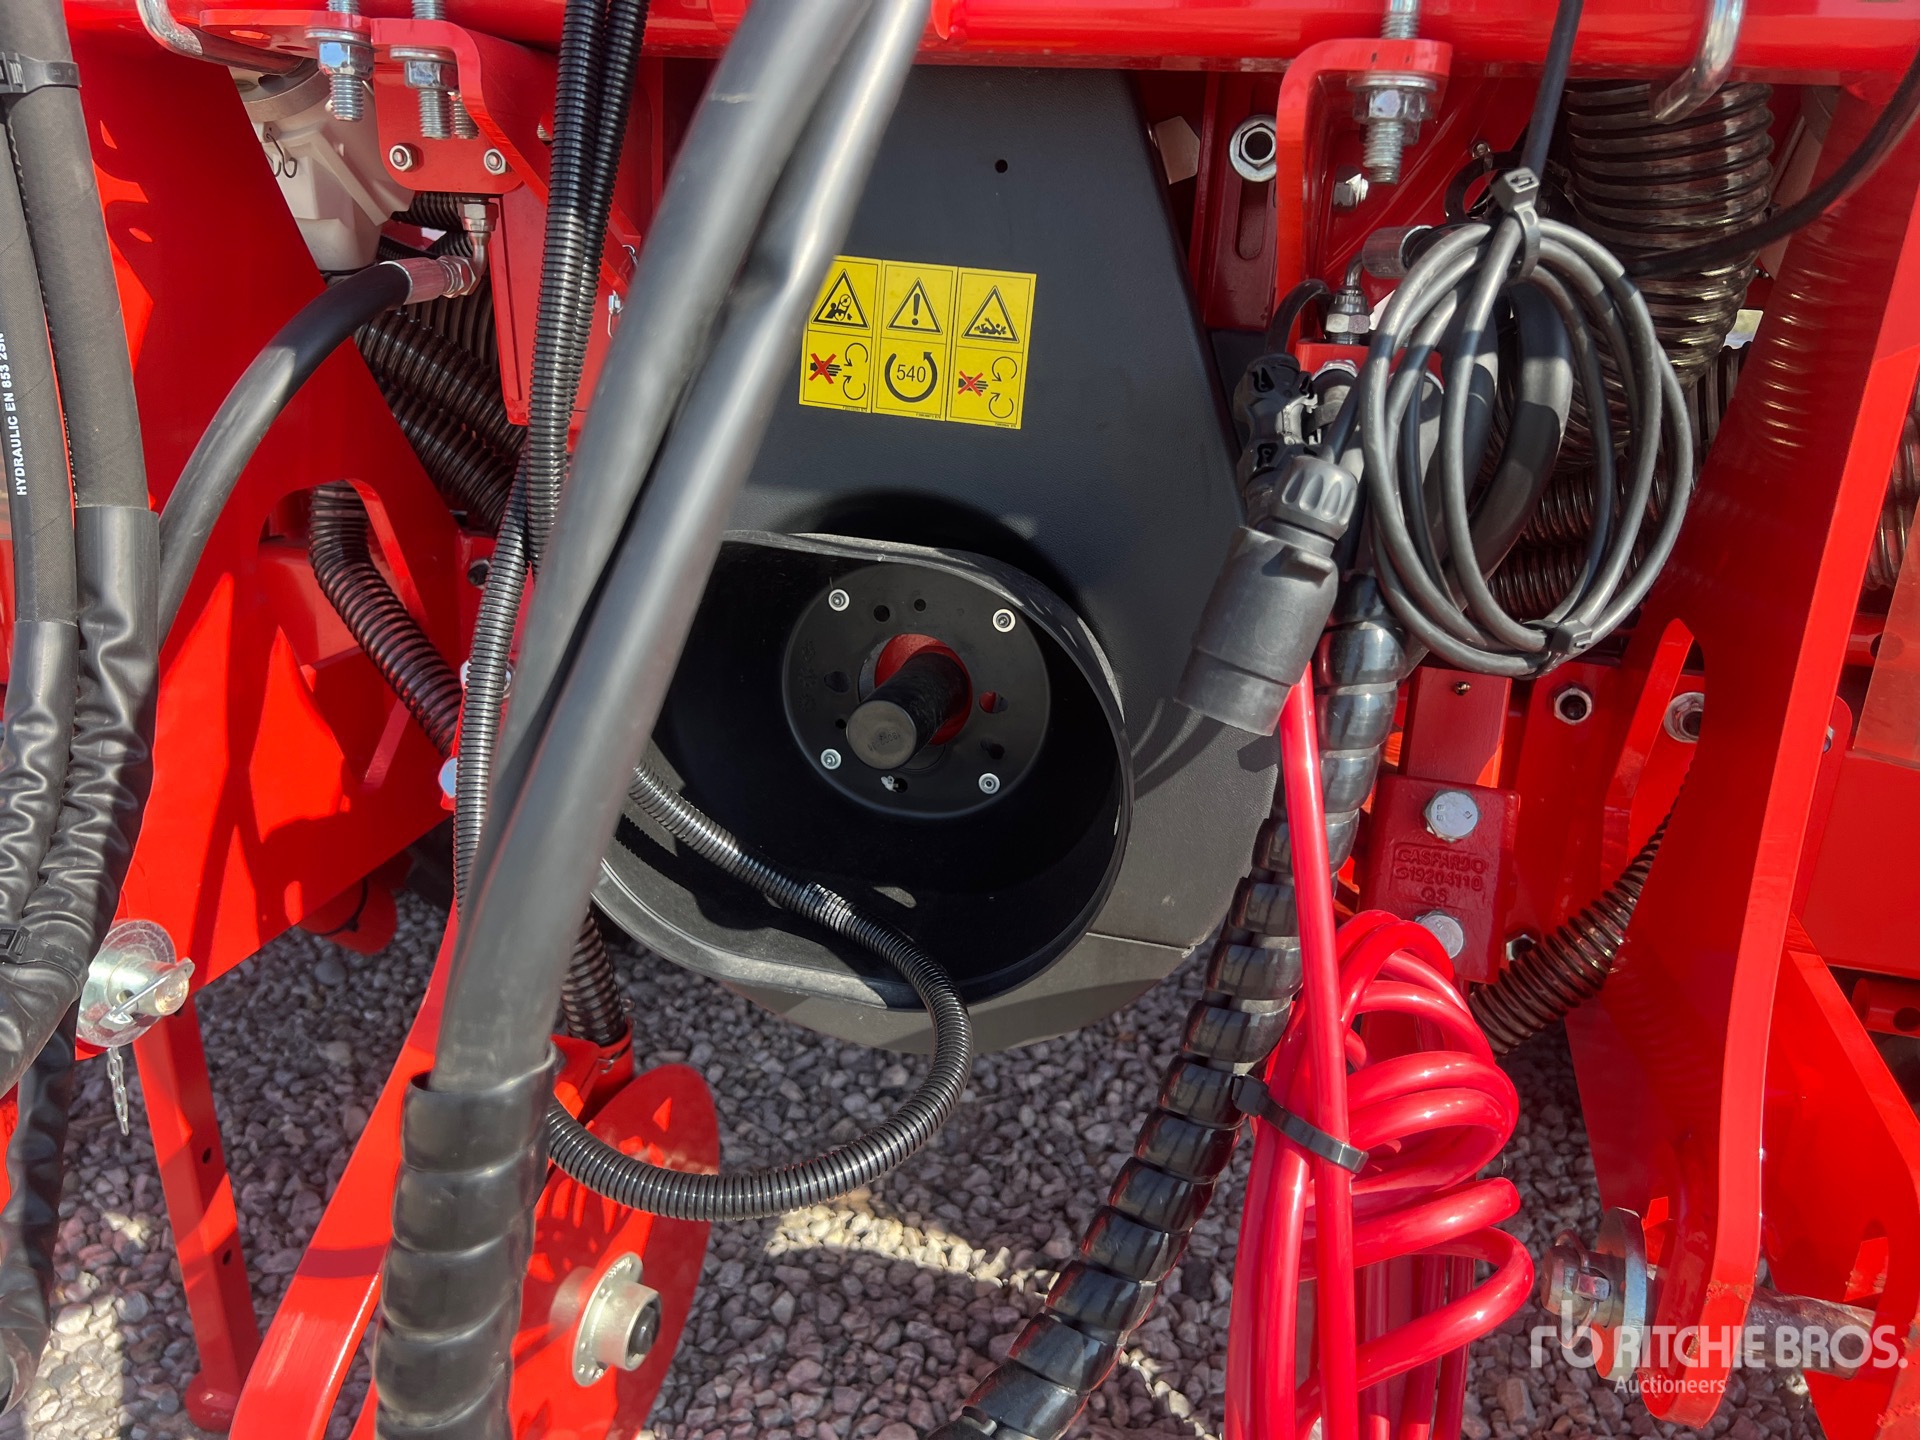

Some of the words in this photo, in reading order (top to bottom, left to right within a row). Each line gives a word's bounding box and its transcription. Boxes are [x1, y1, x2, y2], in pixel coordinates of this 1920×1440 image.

[0, 364, 12, 388] 853
[896, 364, 926, 383] 540
[3, 392, 16, 412] EN
[7, 415, 27, 496] HYDRAULIC
